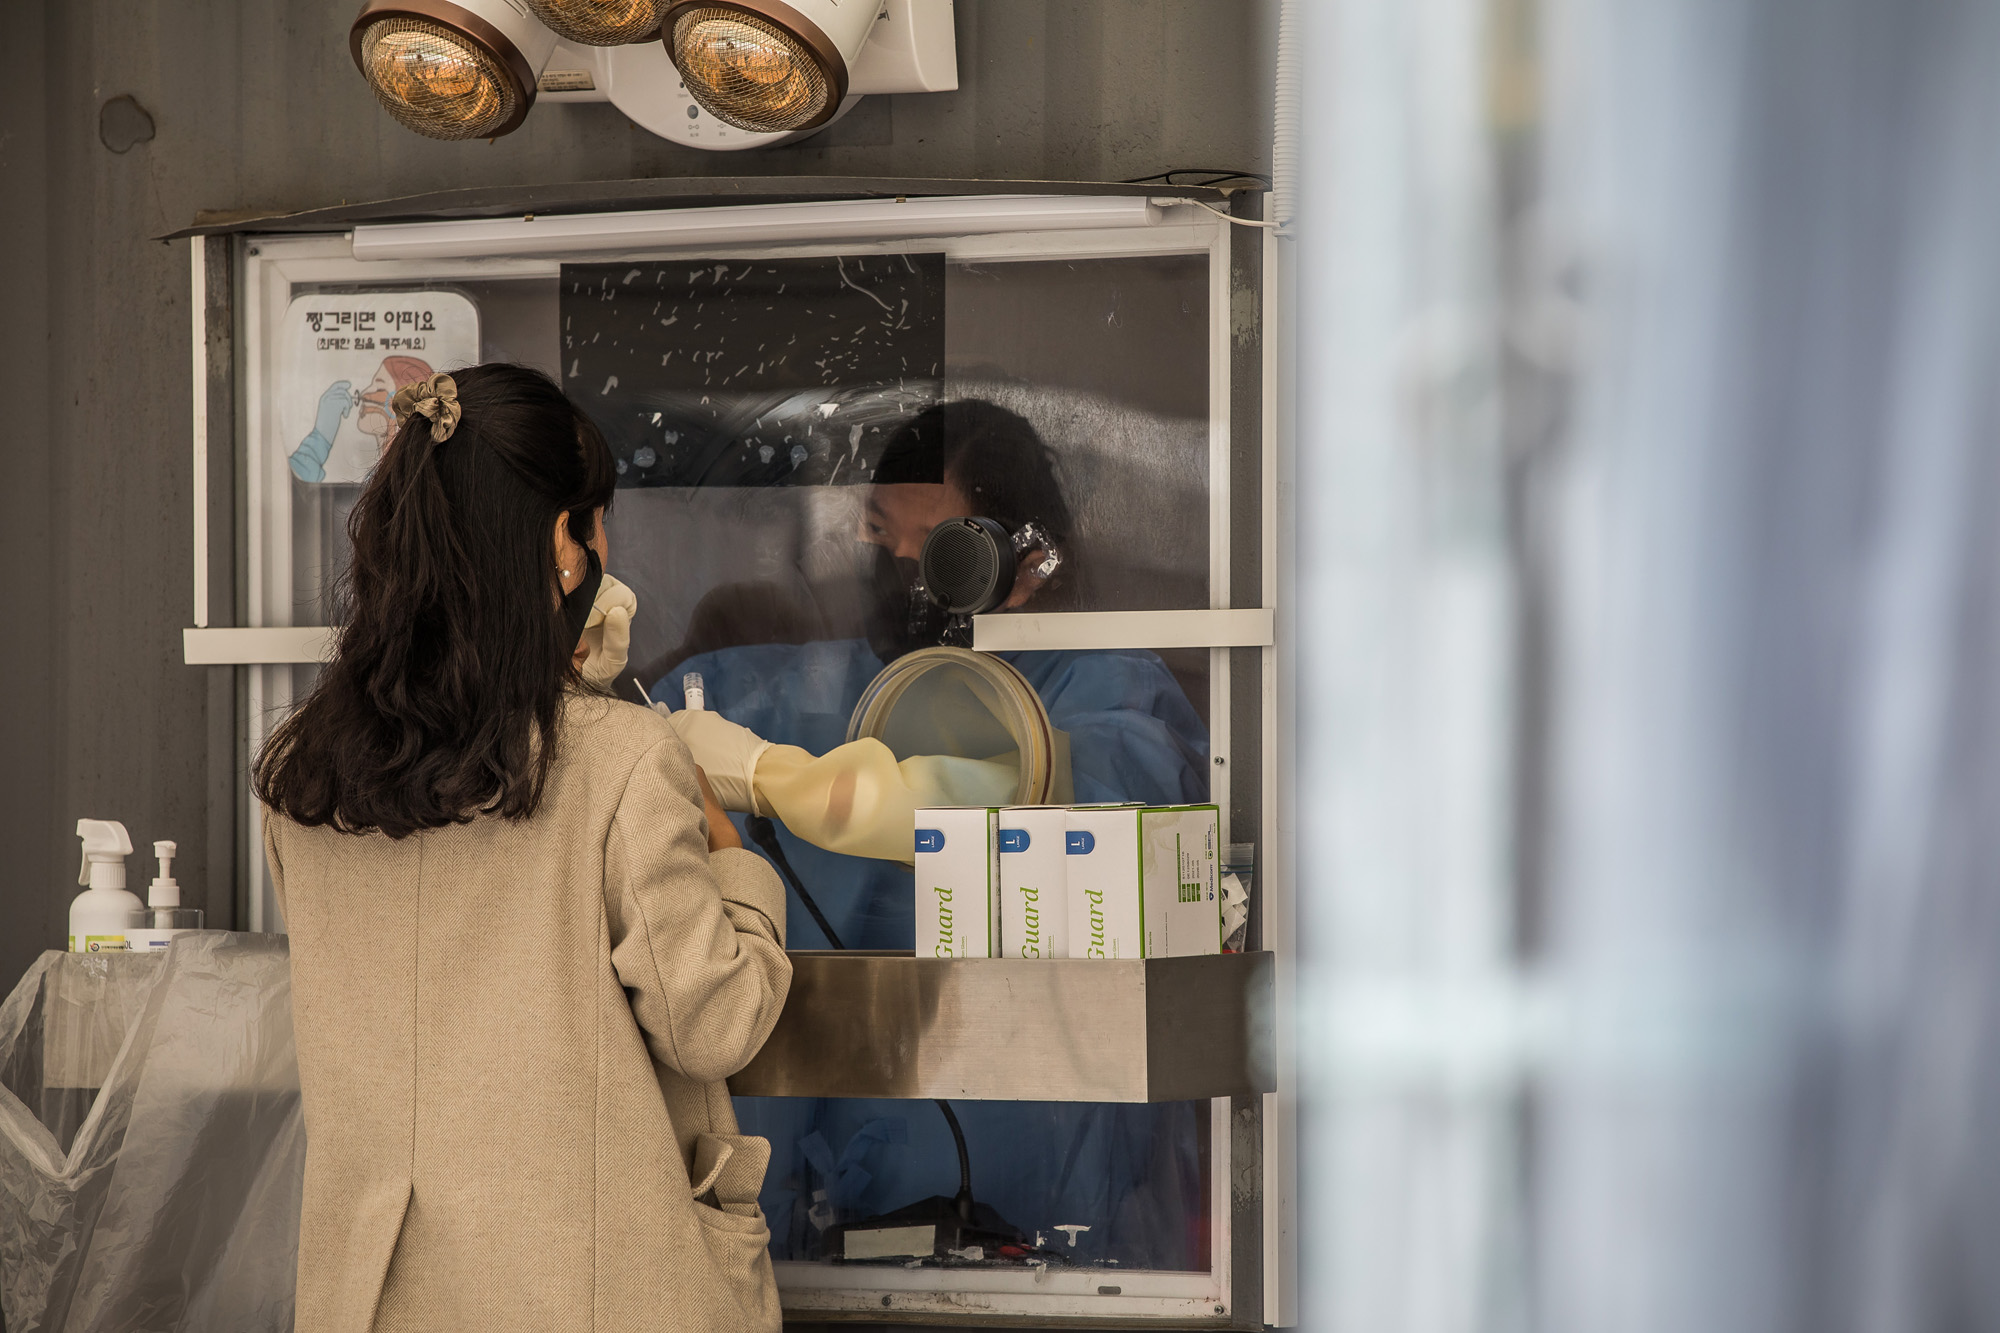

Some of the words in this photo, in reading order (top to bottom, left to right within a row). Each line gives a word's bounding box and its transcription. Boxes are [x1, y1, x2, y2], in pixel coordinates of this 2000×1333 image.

[306, 311, 376, 332] 찡그리면
[384, 311, 436, 332] 아파요
[354, 337, 375, 350] 힘을
[934, 887, 953, 958] Guard
[1020, 887, 1040, 959] Guard
[1085, 889, 1105, 959] Guard
